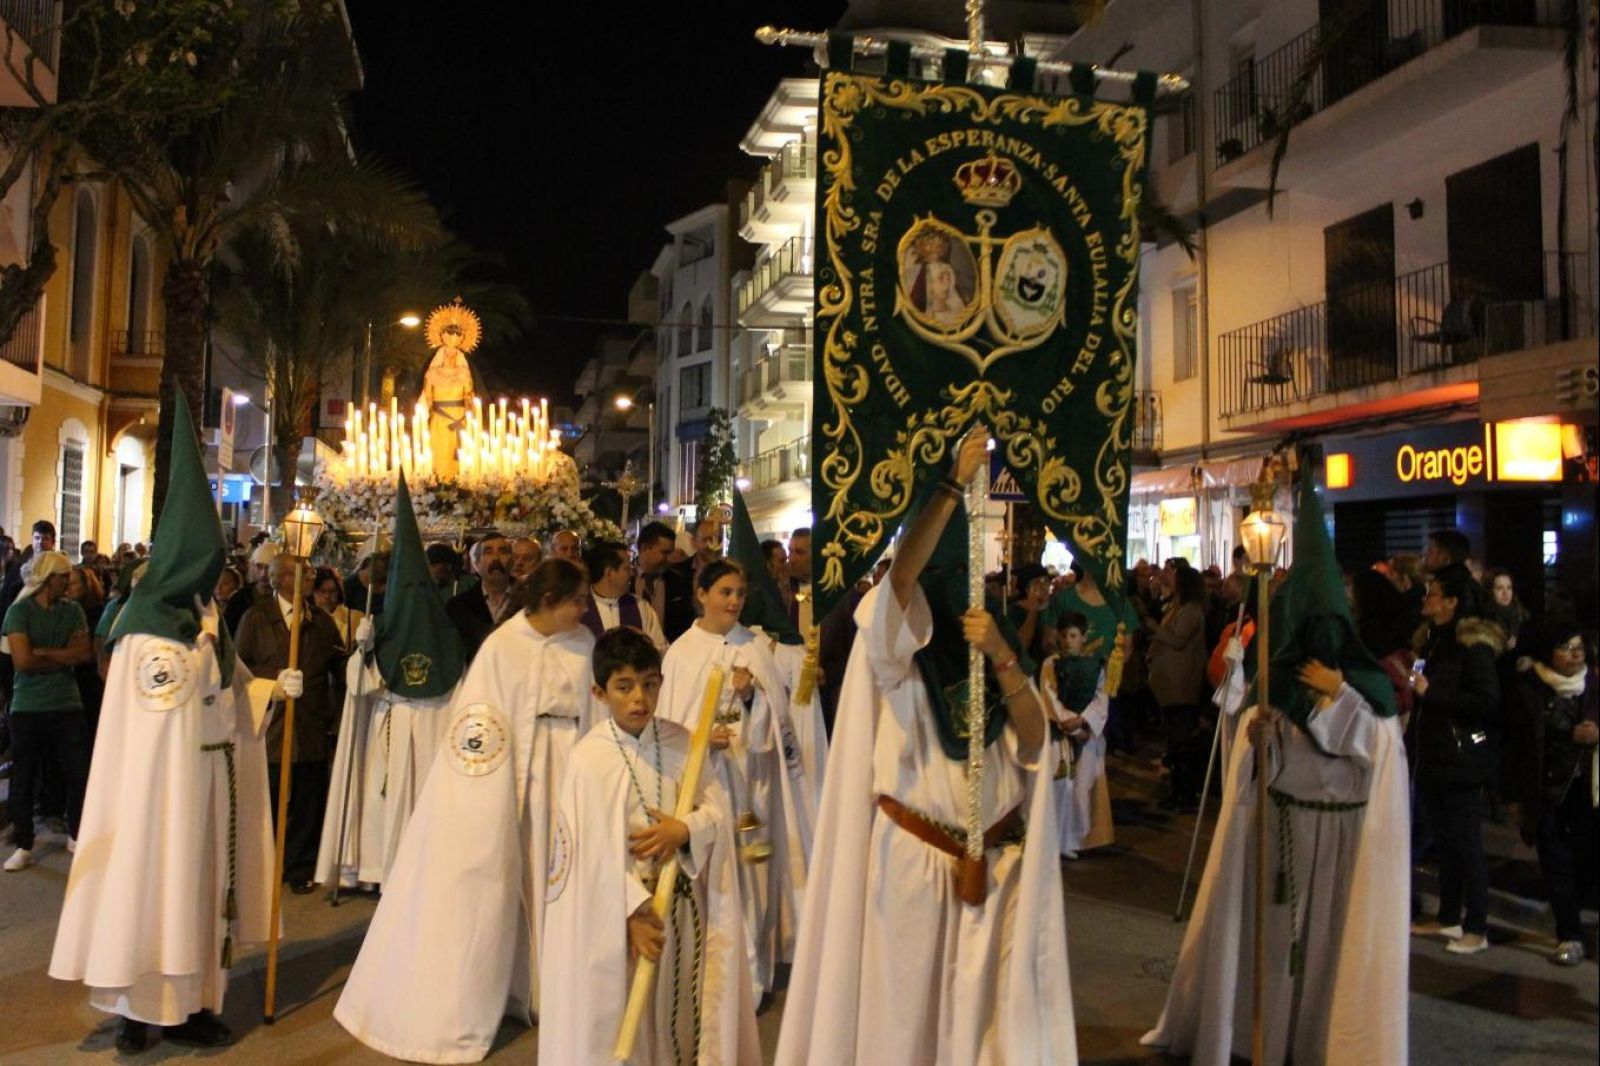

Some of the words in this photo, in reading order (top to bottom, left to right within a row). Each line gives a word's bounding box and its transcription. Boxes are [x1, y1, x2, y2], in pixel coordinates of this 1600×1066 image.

[896, 148, 925, 174] LA
[876, 168, 901, 202] DE
[1085, 231, 1108, 326] EULALIA
[1071, 332, 1101, 376] DEL
[1042, 377, 1075, 414] RIO
[1397, 444, 1483, 486] Orange
